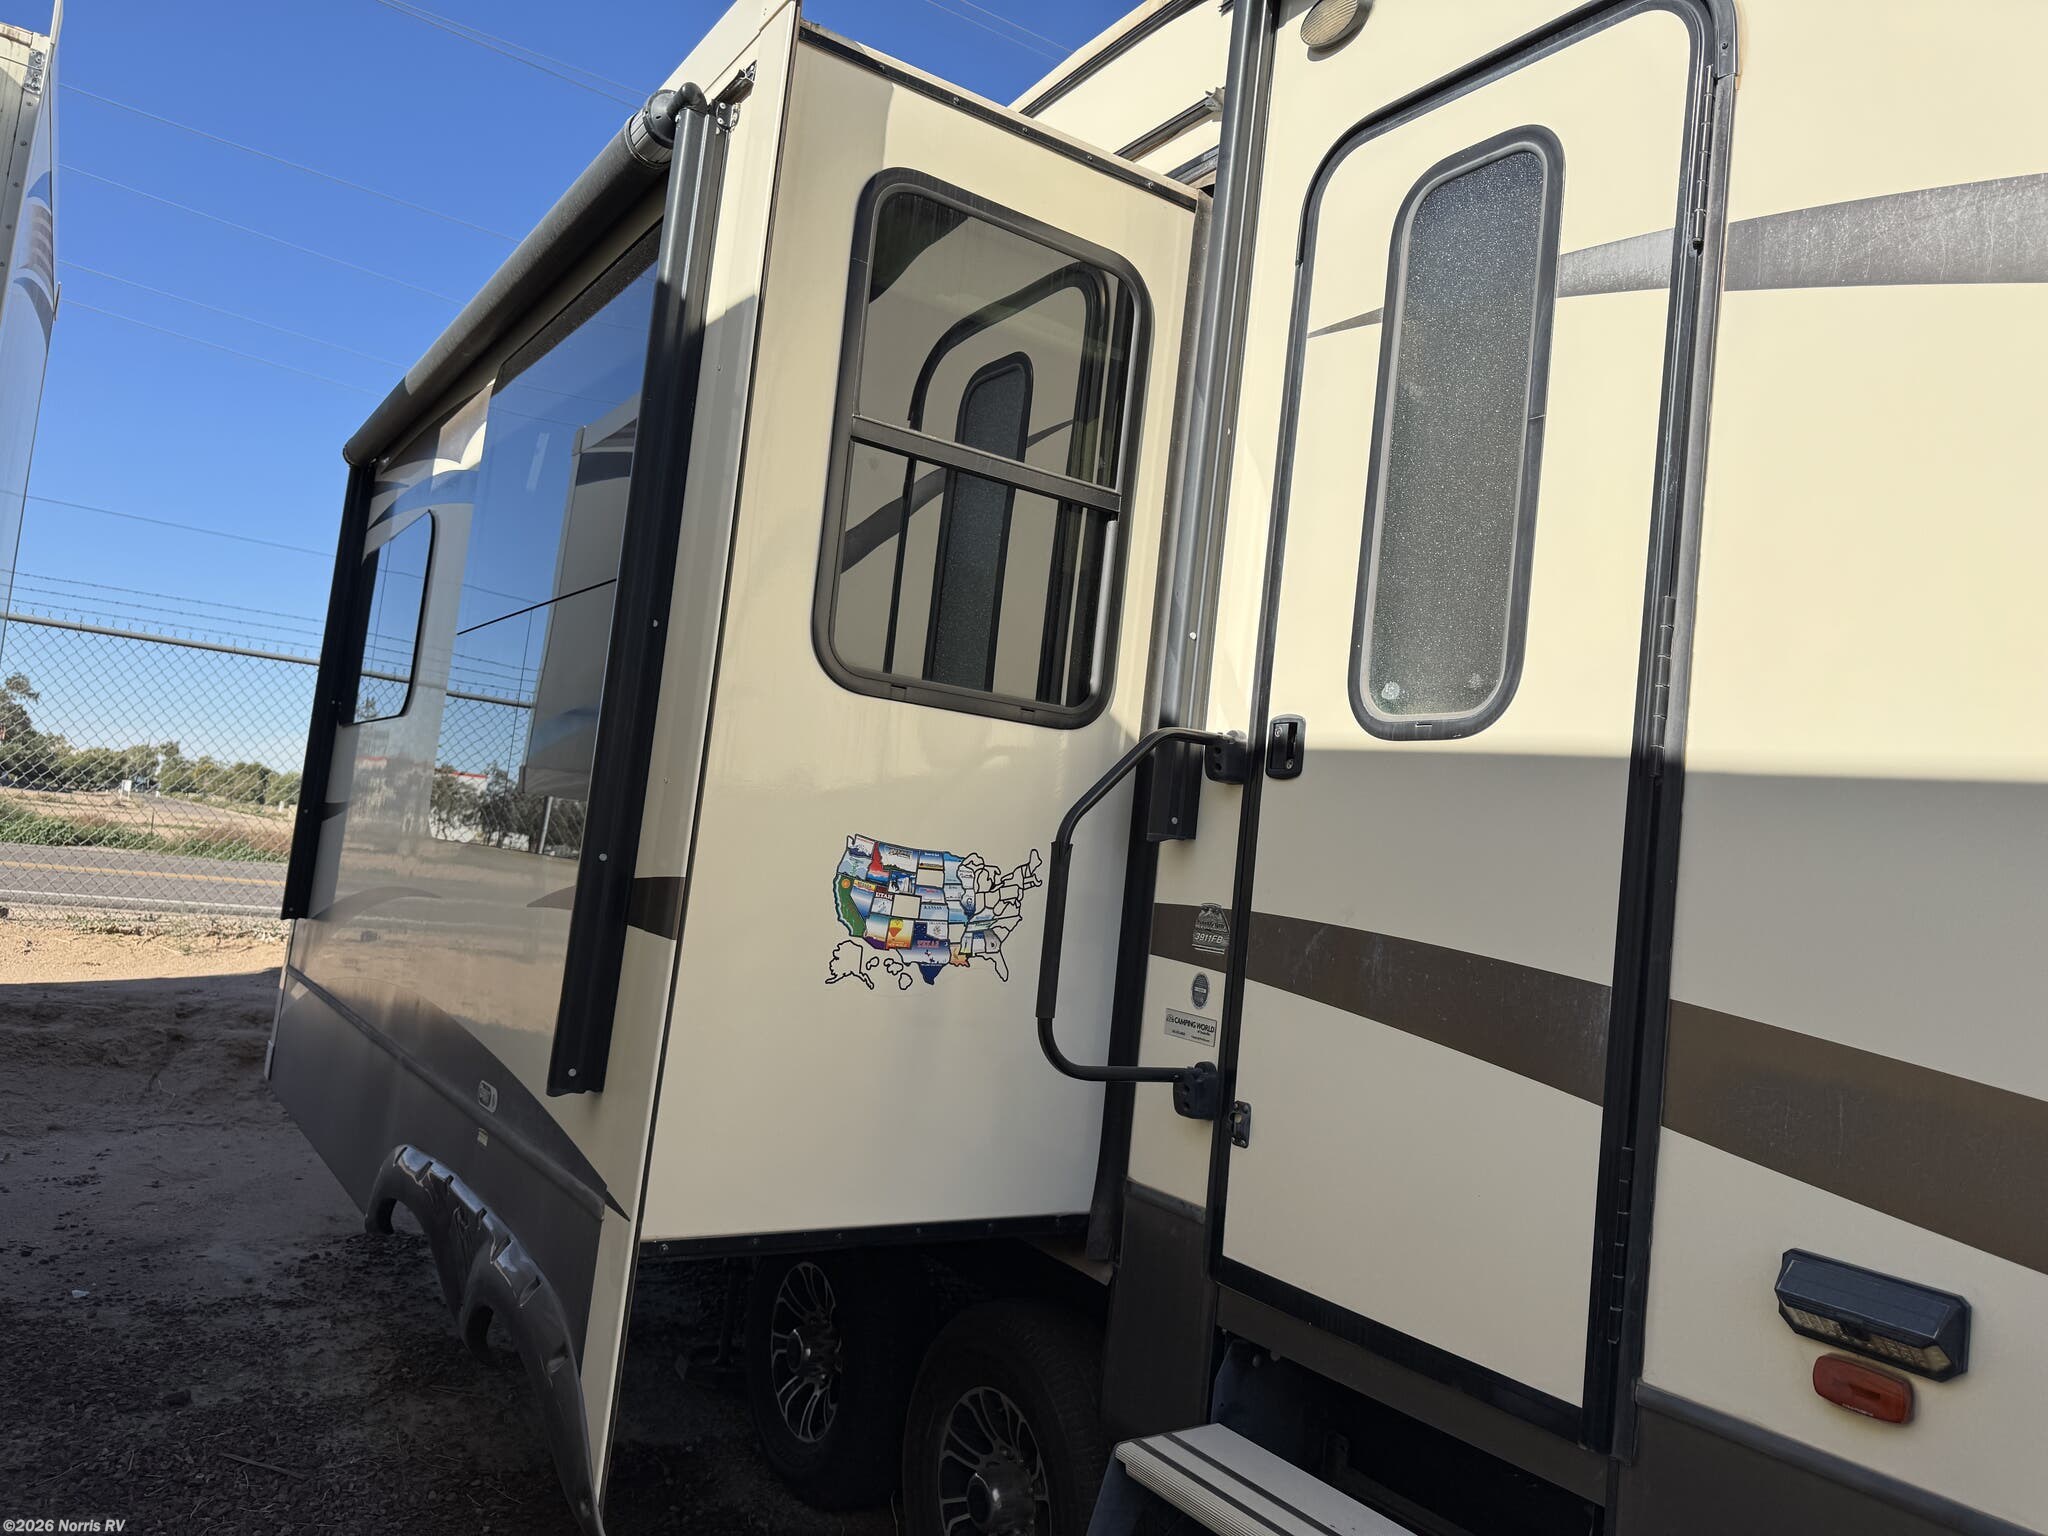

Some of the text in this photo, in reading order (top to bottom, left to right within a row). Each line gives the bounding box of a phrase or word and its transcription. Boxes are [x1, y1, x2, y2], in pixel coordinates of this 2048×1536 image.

[875, 892, 894, 900] UTAH
[1194, 932, 1224, 944] 3911FB
[917, 940, 940, 948] TEXAS
[1174, 1016, 1196, 1028] CAMPING
[1197, 1022, 1215, 1033] WORLD
